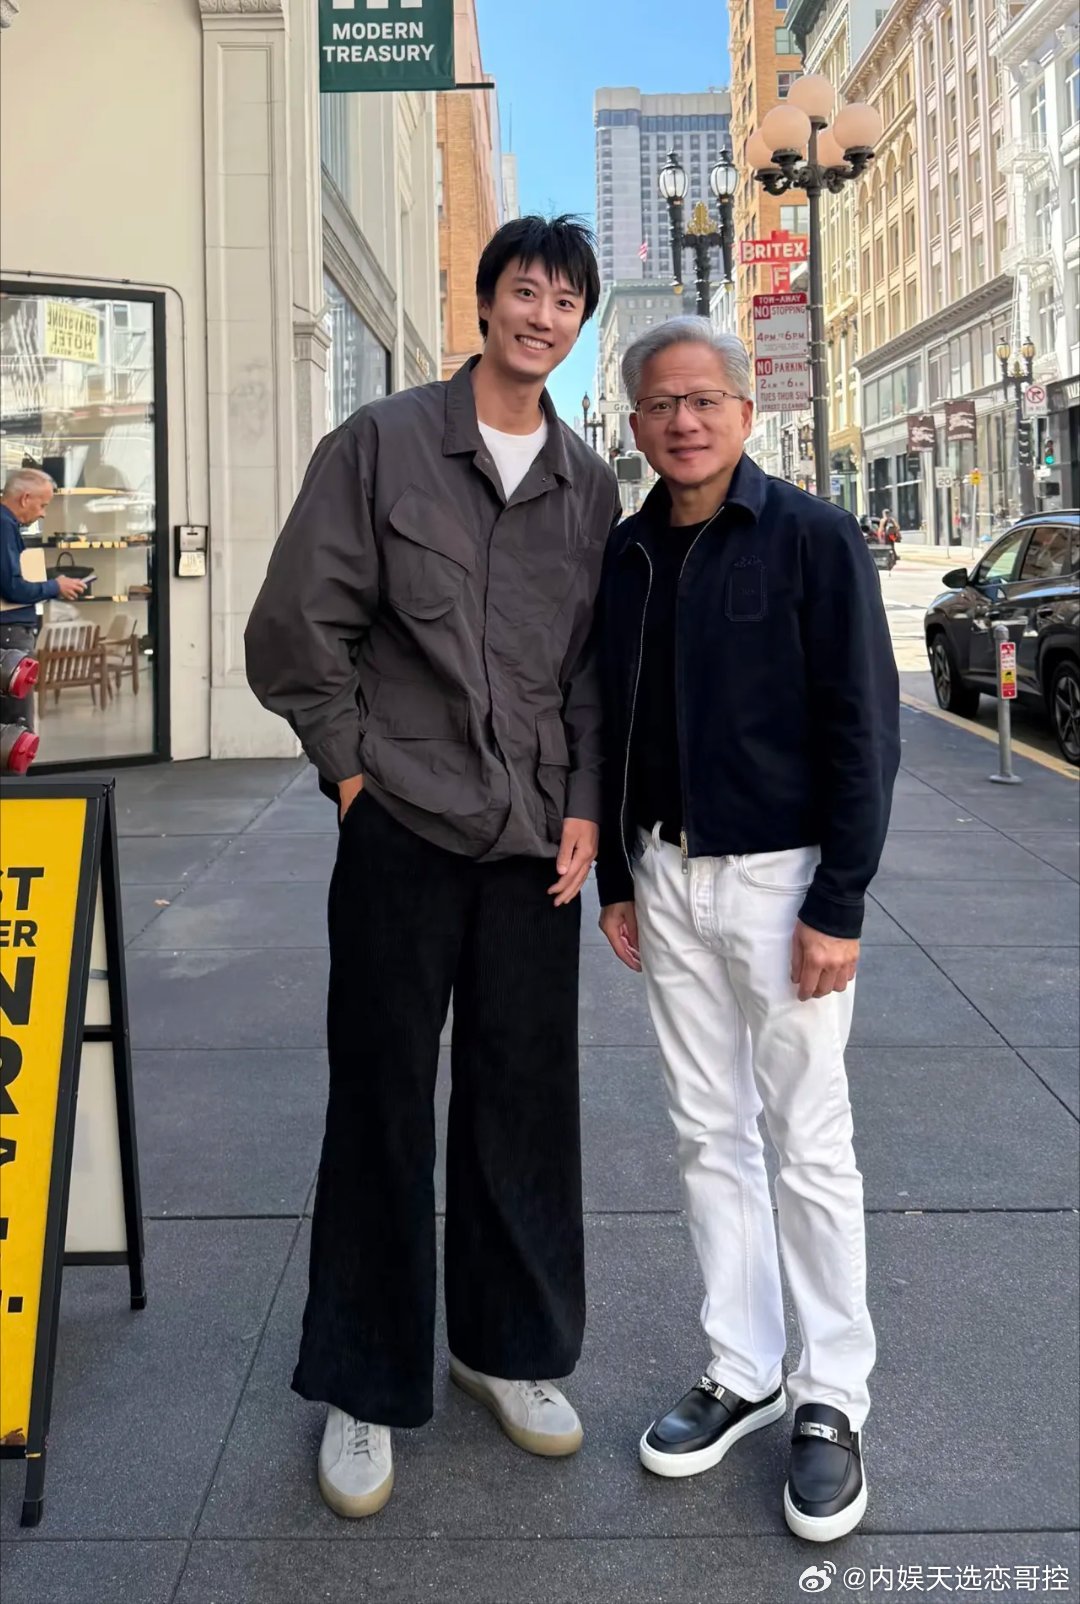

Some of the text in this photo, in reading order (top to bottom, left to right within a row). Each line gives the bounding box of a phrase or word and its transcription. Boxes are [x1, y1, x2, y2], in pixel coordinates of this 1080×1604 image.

[332, 21, 423, 40] MODERN
[322, 44, 434, 62] TREASURY
[742, 242, 805, 262] BRITEX
[773, 266, 789, 293] F
[758, 295, 801, 304] TOW-AWAY
[754, 305, 806, 318] NO STOPPING
[756, 360, 808, 375] NO PARKING
[614, 403, 631, 411] Gra
[938, 477, 951, 486] 20
[0, 867, 45, 911] T
